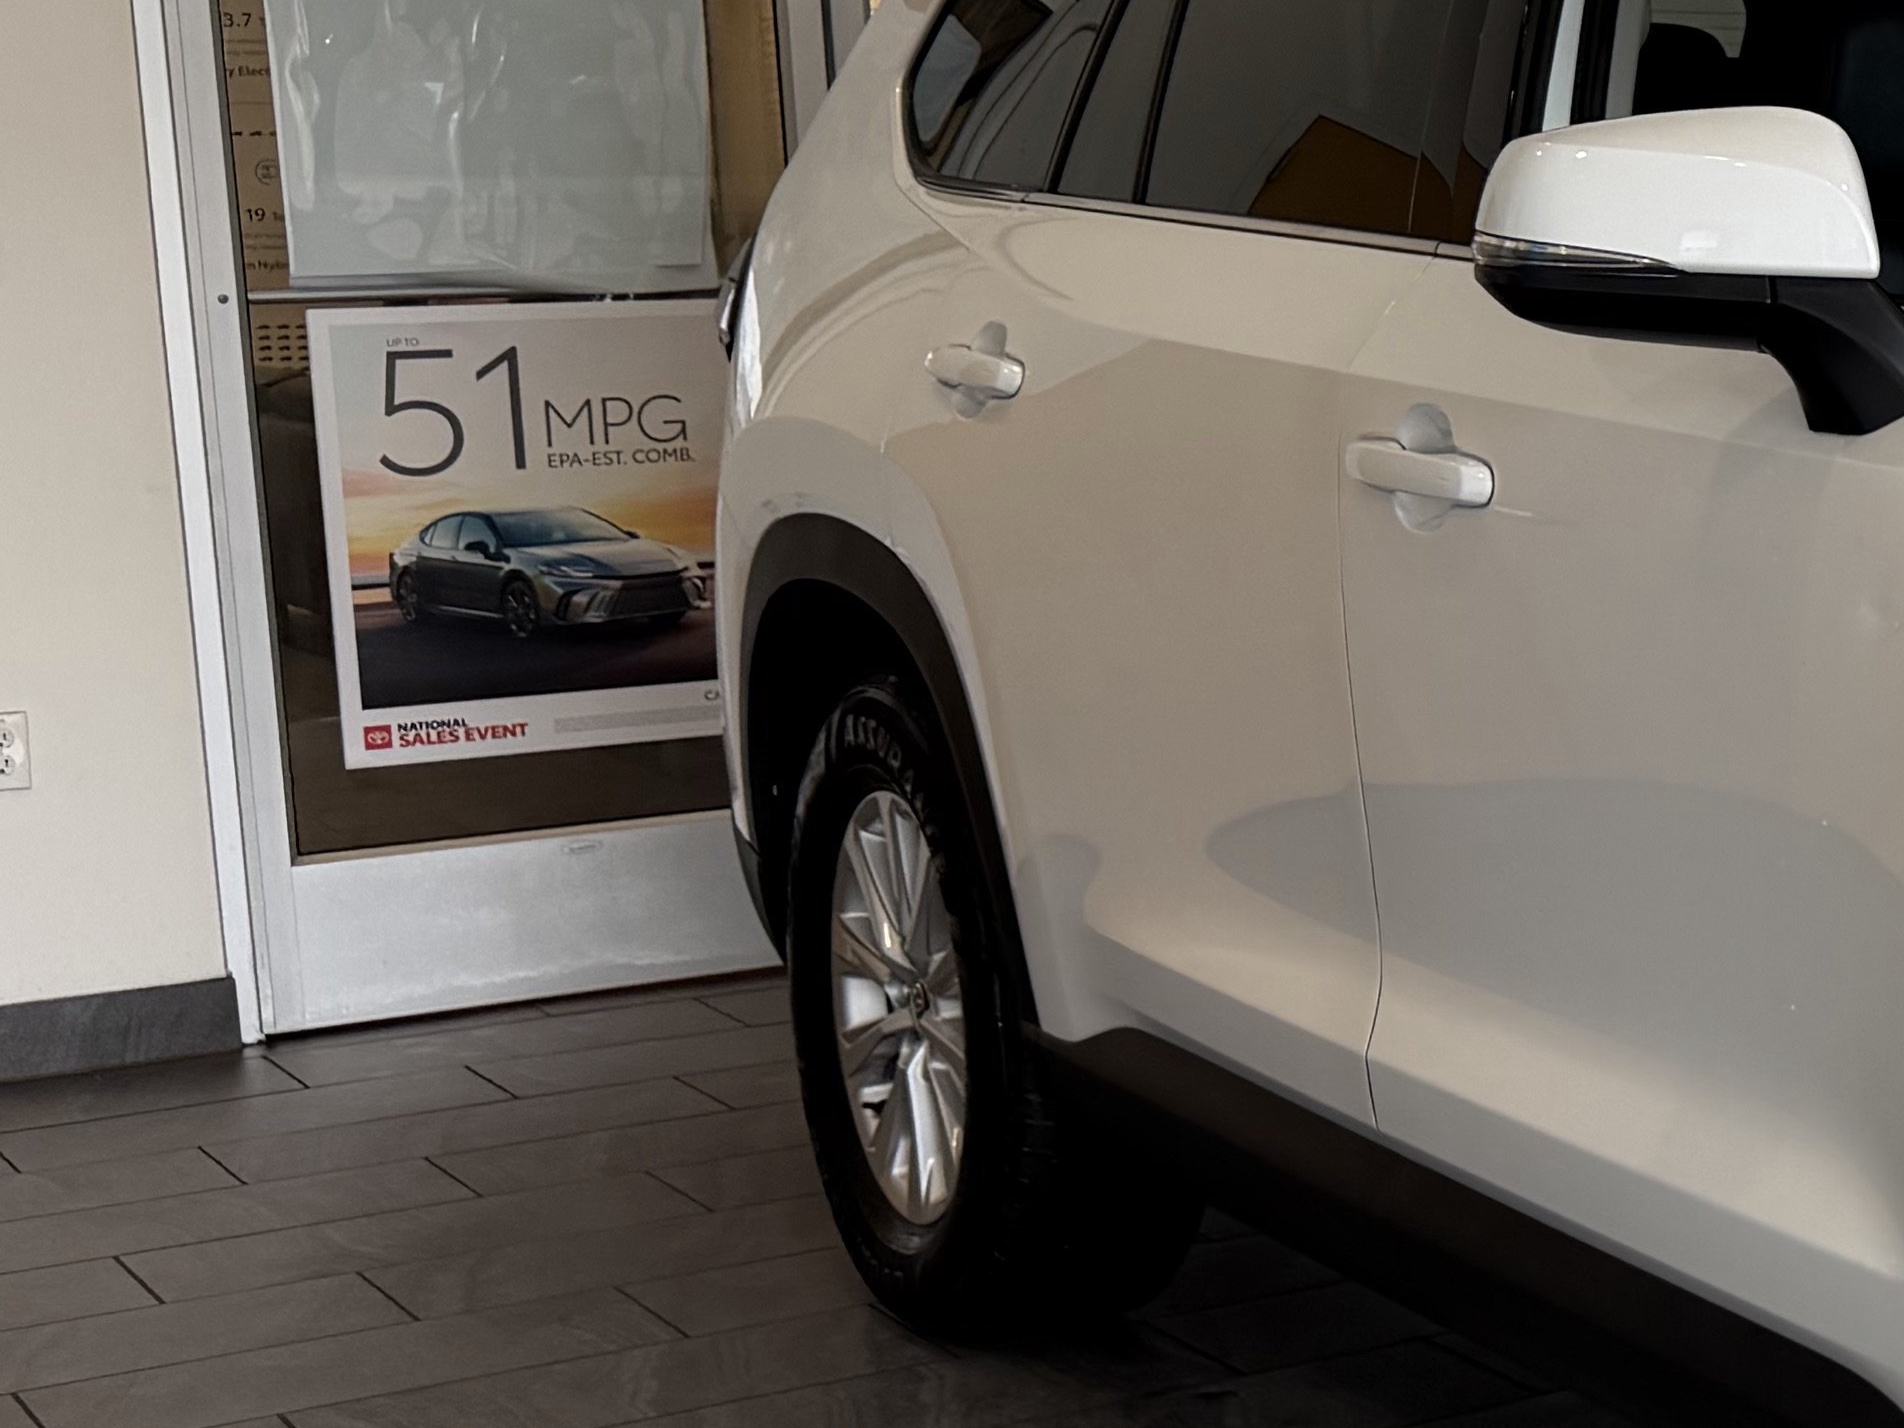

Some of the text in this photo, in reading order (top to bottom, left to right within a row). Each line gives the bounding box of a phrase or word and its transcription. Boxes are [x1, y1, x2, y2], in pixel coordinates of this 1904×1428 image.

[379, 345, 527, 477] 51
[544, 394, 689, 448] MPG
[547, 447, 696, 469] EPA-EST. COMB.
[397, 717, 468, 733] NATIONAL
[398, 722, 528, 748] SALES EVENT
